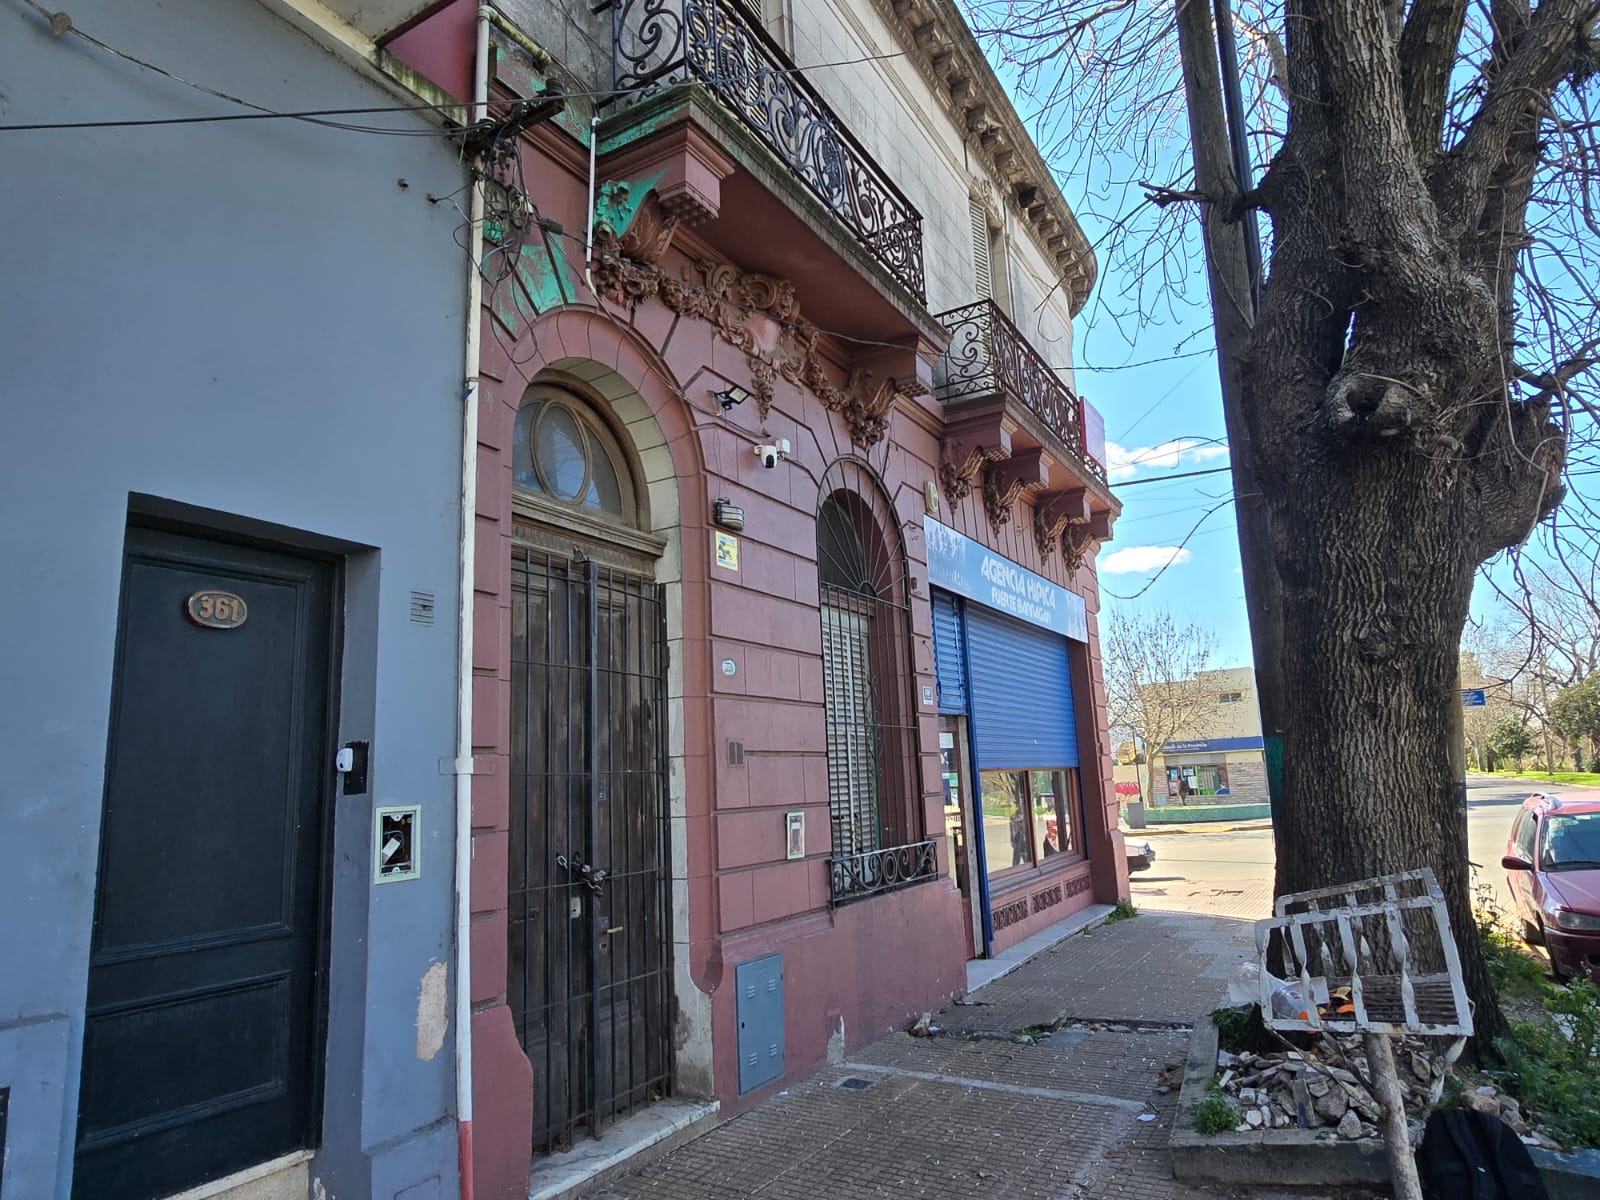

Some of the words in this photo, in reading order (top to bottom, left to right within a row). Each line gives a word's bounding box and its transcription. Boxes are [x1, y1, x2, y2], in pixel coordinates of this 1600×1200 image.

[981, 555, 1026, 596] AGENCIA
[1027, 578, 1056, 610] HIPICA
[199, 595, 239, 622] 361
[991, 587, 1017, 611] FUERTE
